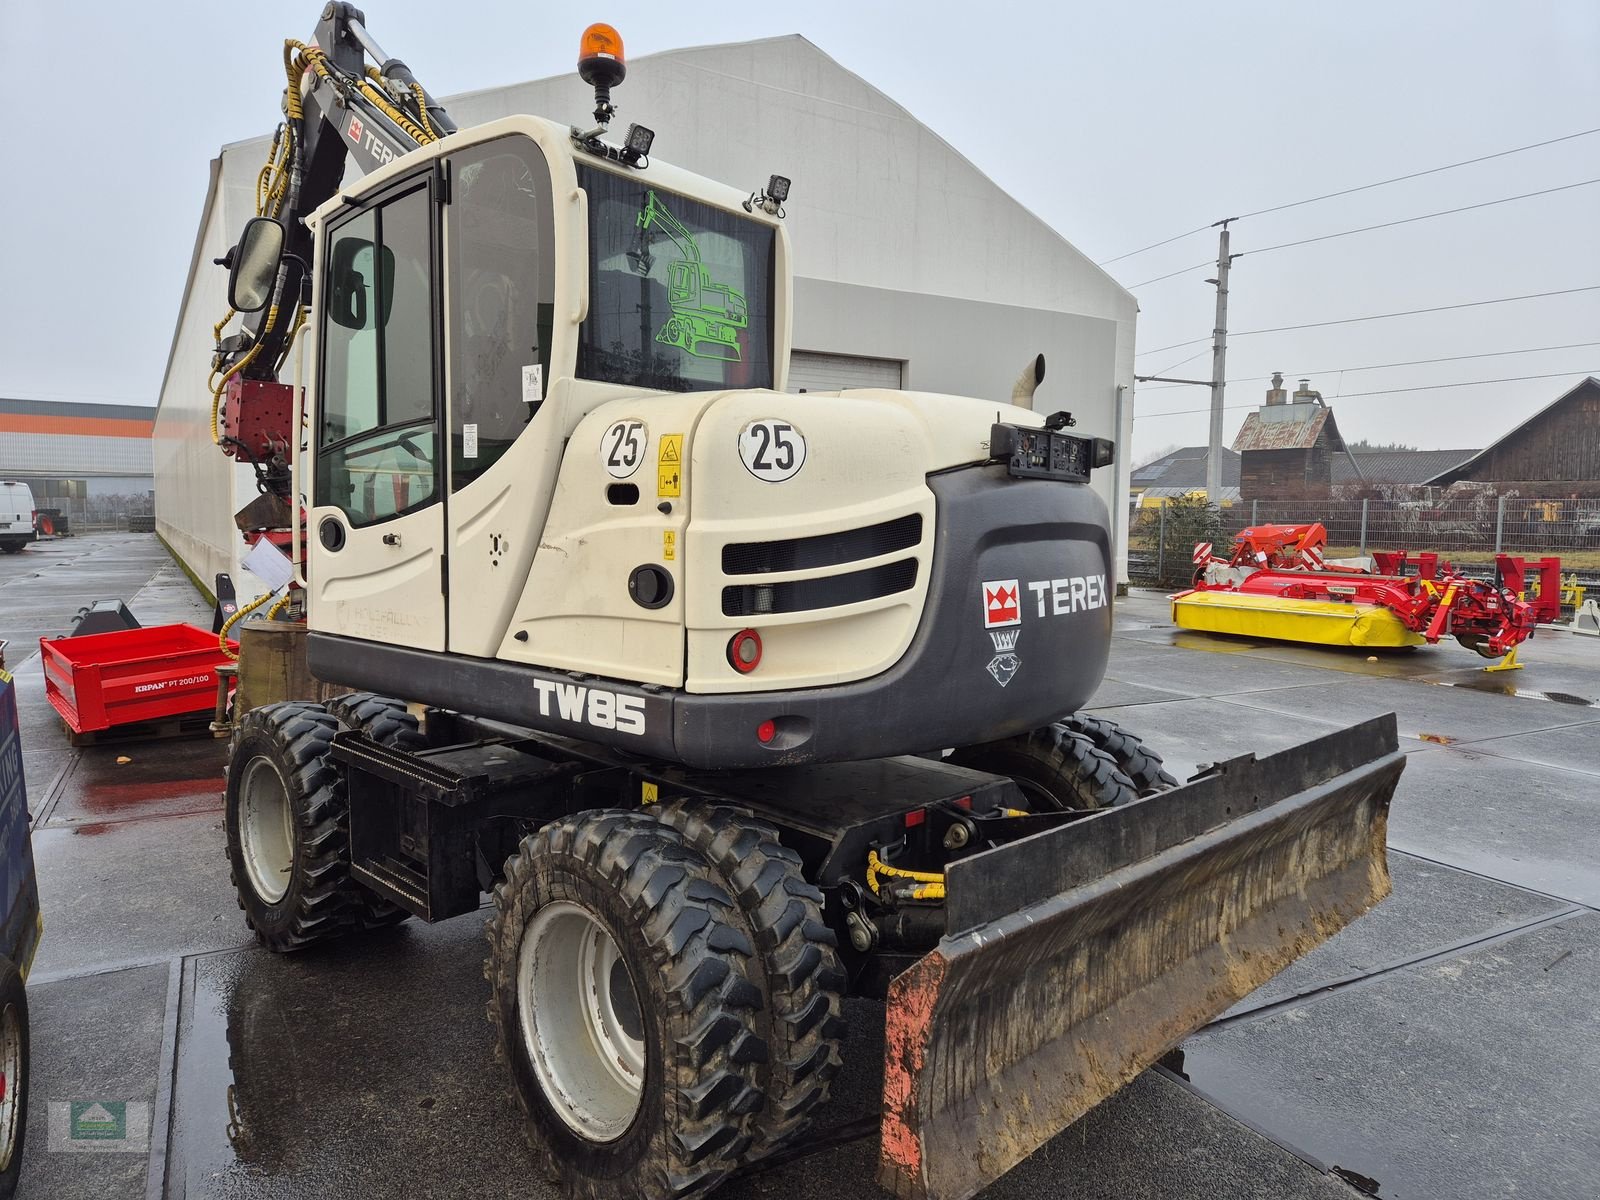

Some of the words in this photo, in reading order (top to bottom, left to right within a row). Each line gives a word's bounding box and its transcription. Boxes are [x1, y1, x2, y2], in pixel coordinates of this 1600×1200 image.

[365, 129, 400, 165] TER
[607, 423, 642, 467] 25
[751, 423, 795, 470] 25
[1028, 574, 1108, 618] TEREX
[135, 682, 165, 693] KRPAN
[168, 679, 178, 687] PT
[179, 674, 209, 686] 200/100
[533, 678, 646, 736] TW85
